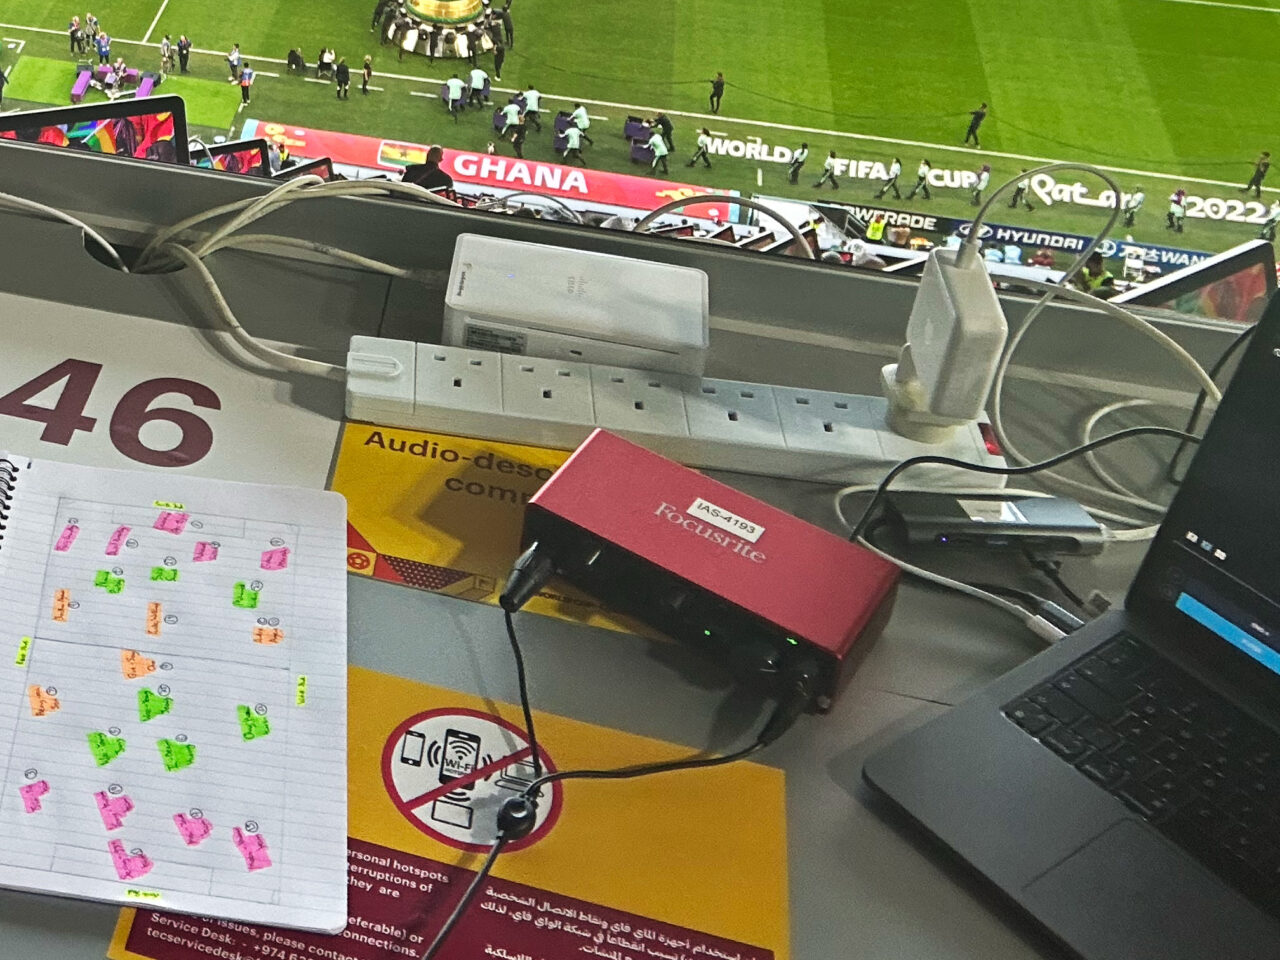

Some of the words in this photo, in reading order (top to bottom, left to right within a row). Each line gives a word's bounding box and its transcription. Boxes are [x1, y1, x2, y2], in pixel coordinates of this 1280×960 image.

[454, 154, 588, 193] GHANA
[707, 137, 793, 164] WORLD
[833, 158, 888, 181] FIFA
[928, 168, 977, 189] CUP
[1031, 173, 1133, 210] Qatar
[1184, 195, 1267, 225] 2022
[997, 228, 1084, 250] HYUNDAI
[1161, 250, 1211, 266] WAN
[654, 502, 767, 564] Focusrite
[697, 502, 756, 534] IAS-4193
[347, 849, 390, 867] ersonal
[393, 859, 449, 883] hotspots
[348, 863, 417, 889] erruptions
[419, 883, 433, 893] of
[378, 886, 400, 898] are
[486, 886, 536, 907] الشخصية
[147, 927, 261, 960] tecservicedesk@
[151, 912, 199, 935] Service
[201, 927, 236, 946] Desk:
[340, 929, 420, 958] onnections.
[348, 916, 407, 940] eferable)
[409, 934, 424, 944] or
[263, 931, 306, 951] please
[308, 945, 365, 960] conta
